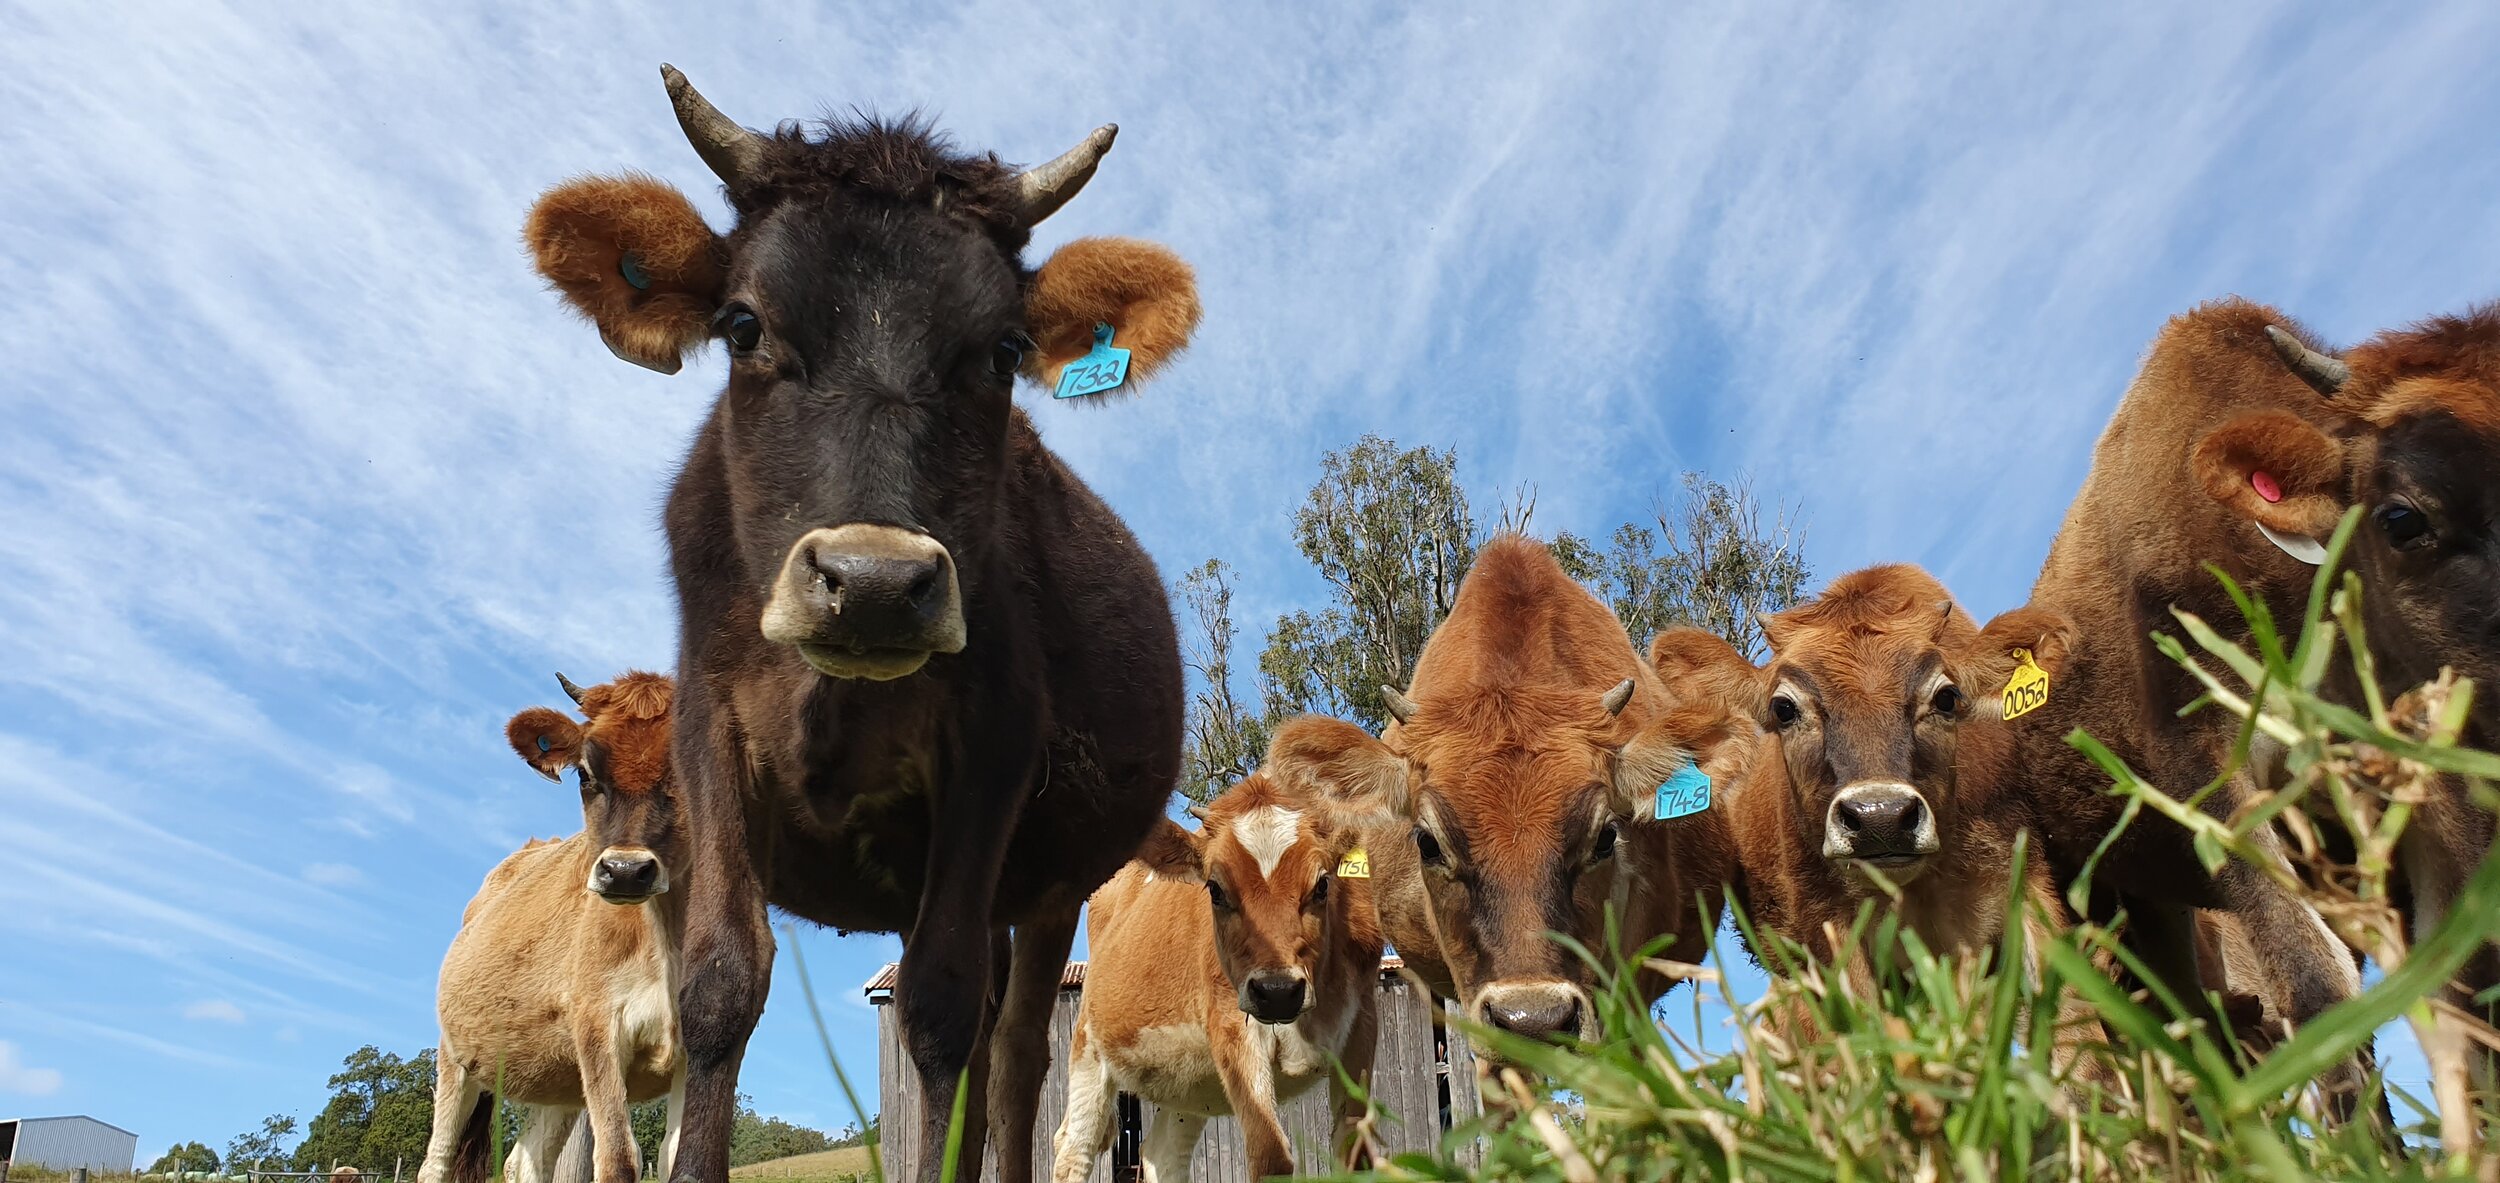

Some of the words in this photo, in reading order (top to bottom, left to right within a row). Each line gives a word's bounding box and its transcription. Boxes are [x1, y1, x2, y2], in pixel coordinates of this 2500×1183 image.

[1055, 359, 1120, 397] 1732
[2004, 677, 2046, 718] 0052
[1657, 784, 1709, 818] 1748
